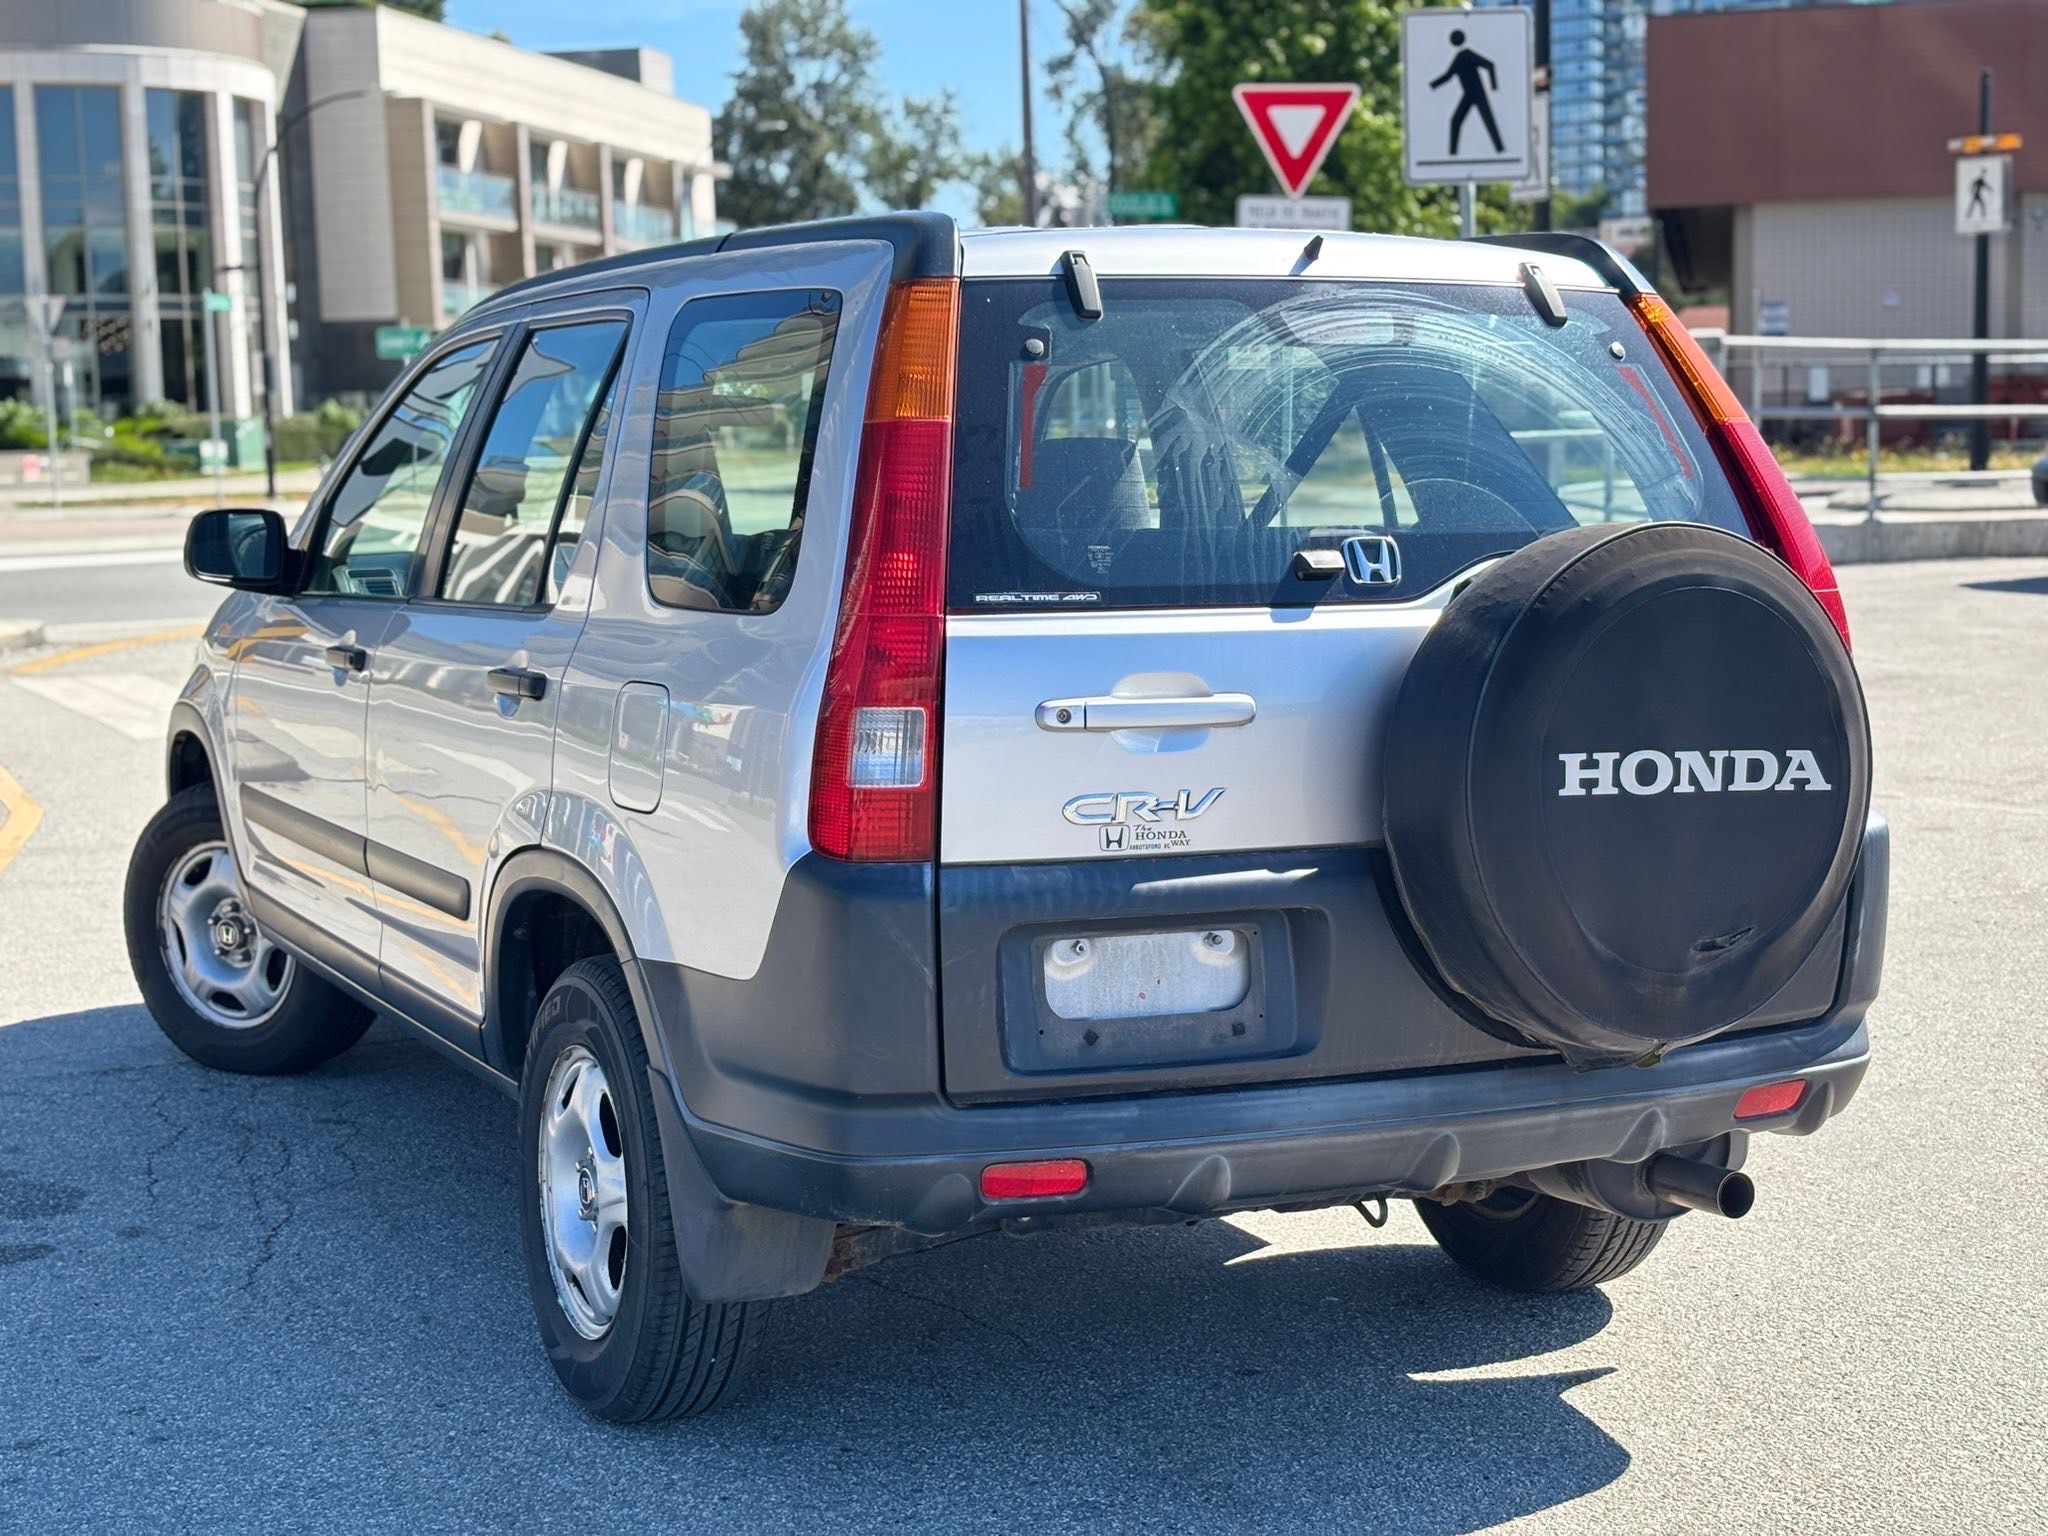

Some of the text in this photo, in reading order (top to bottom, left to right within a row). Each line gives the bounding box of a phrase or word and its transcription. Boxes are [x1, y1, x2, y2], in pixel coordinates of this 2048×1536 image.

[1062, 593, 1099, 601] AWD
[1558, 749, 1832, 797] HONDA
[1062, 787, 1226, 826] CR-V
[1132, 824, 1153, 832] The
[1135, 830, 1188, 841] HONDA
[1170, 839, 1191, 847] WAY
